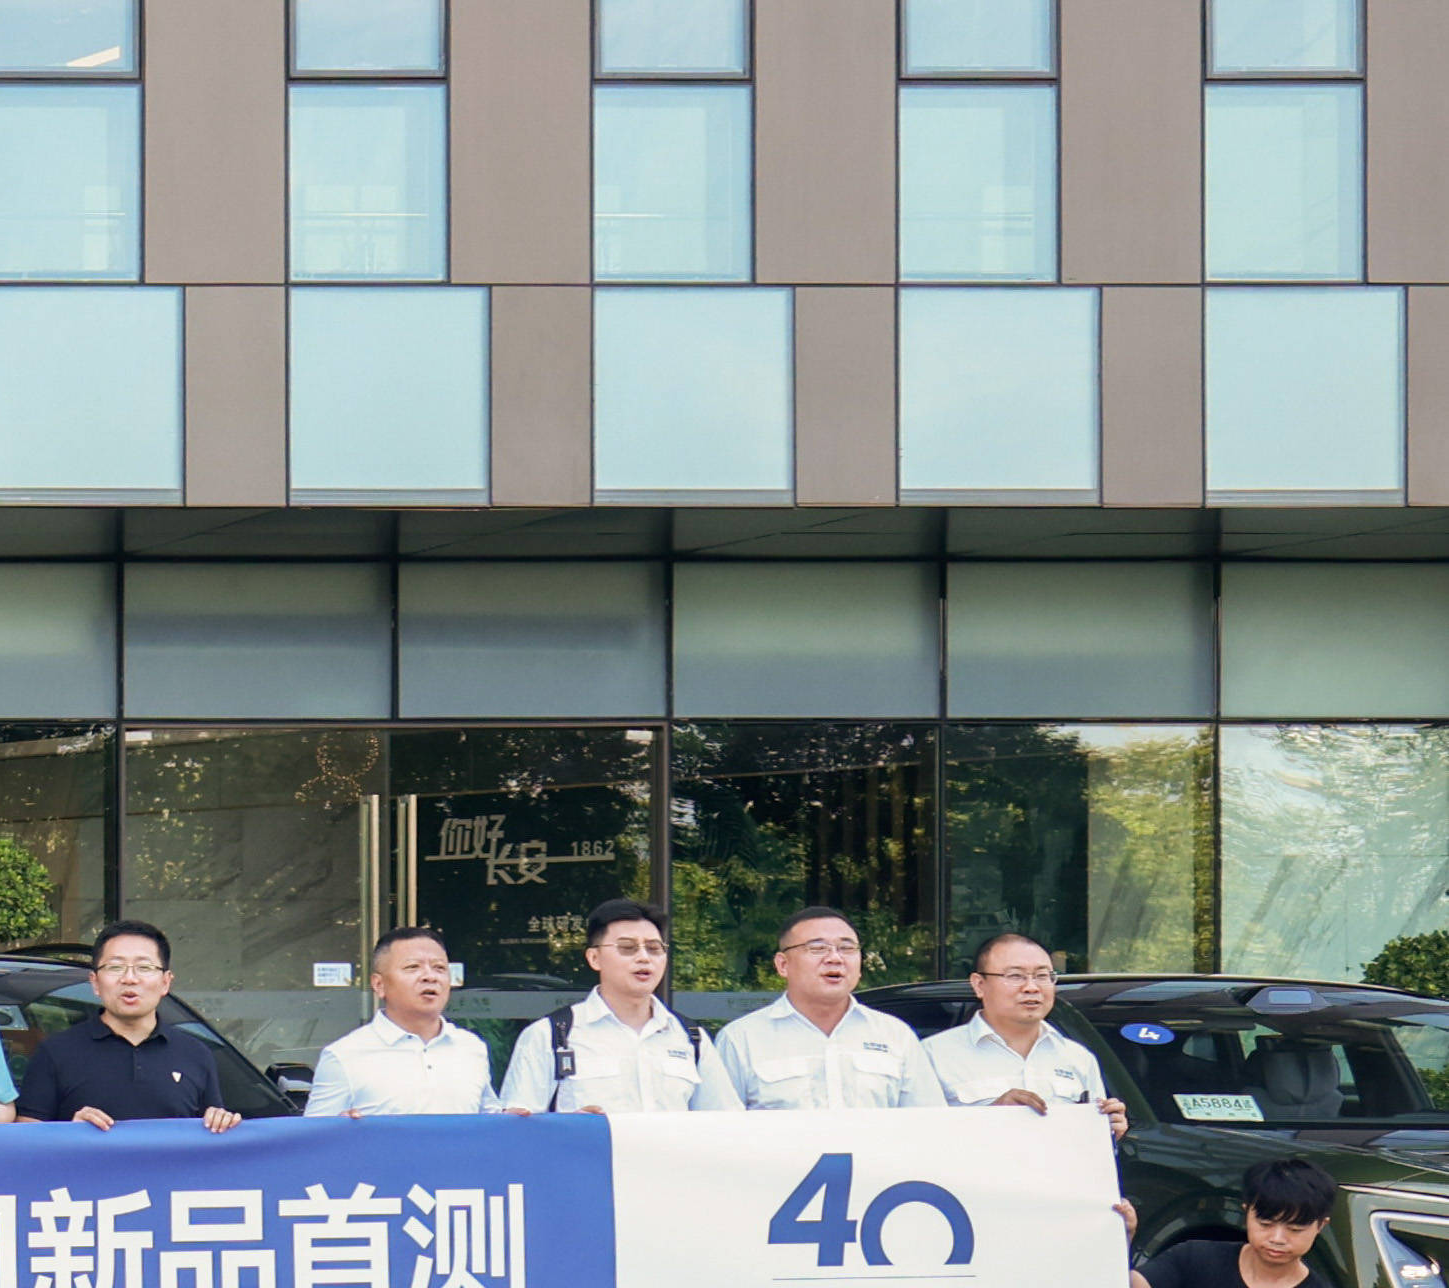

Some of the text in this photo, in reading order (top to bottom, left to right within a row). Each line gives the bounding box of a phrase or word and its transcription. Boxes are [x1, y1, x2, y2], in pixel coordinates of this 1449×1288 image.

[439, 814, 506, 859] 你好
[571, 839, 615, 857] 1862
[486, 839, 548, 886] 长安
[527, 915, 590, 933] 全球研发
[768, 1153, 974, 1267] 40
